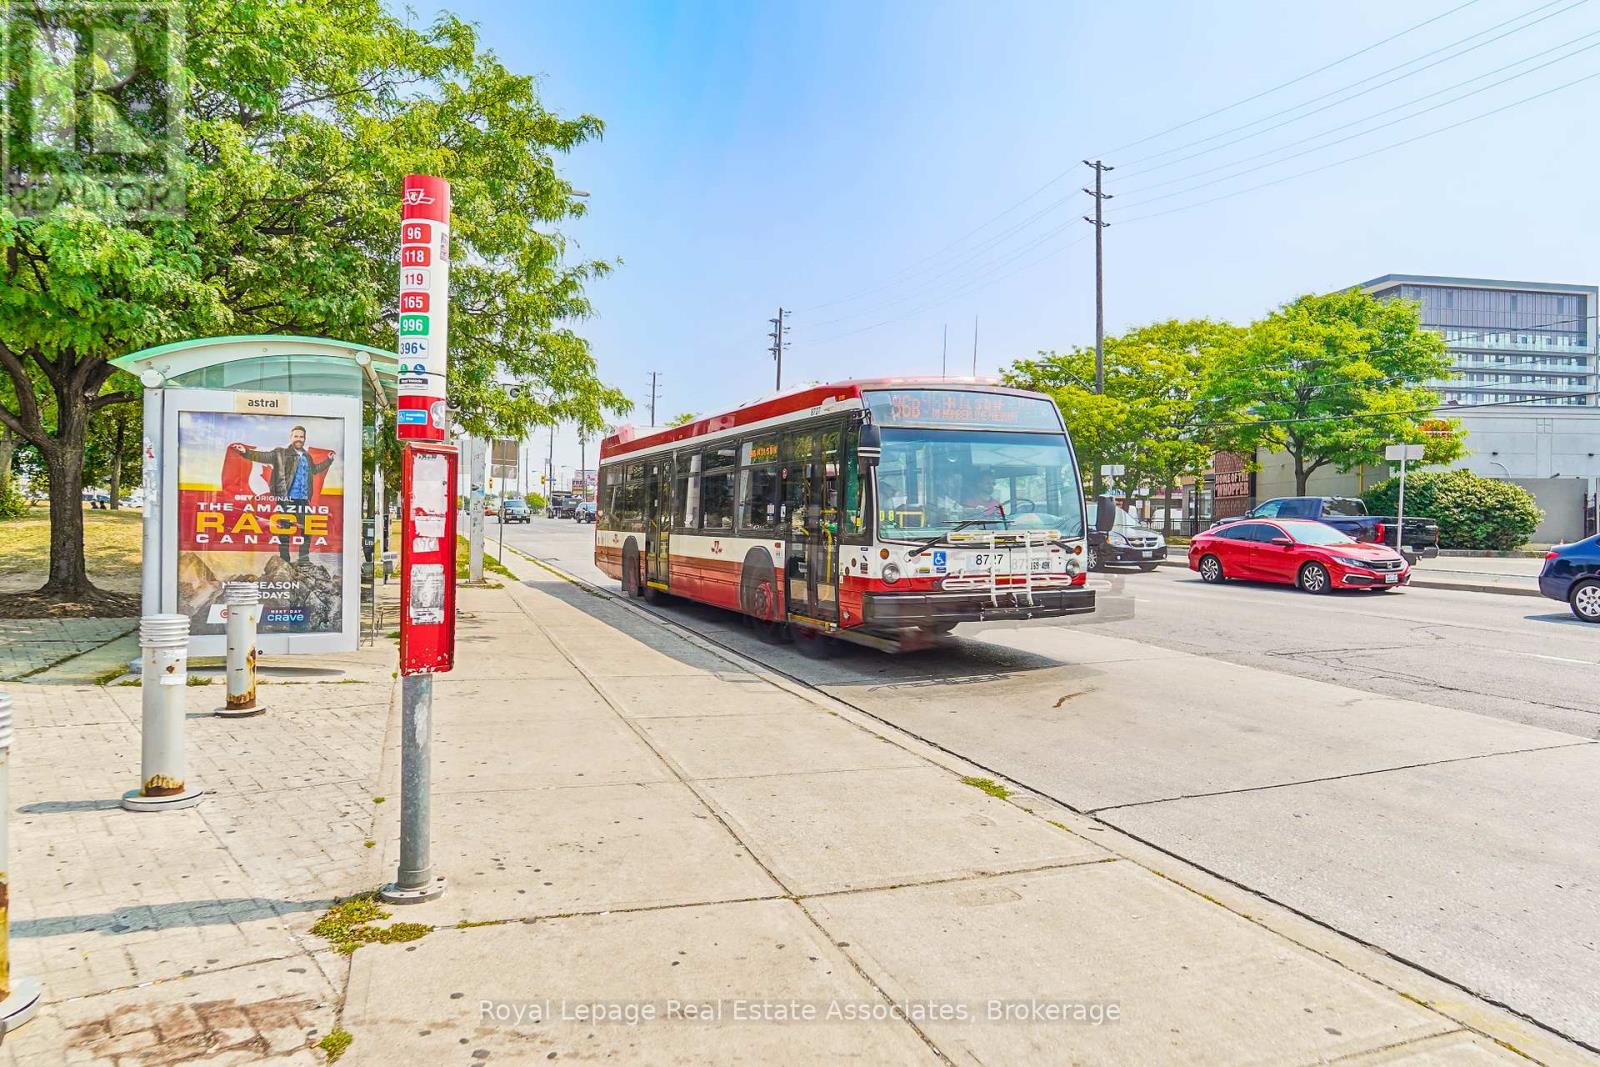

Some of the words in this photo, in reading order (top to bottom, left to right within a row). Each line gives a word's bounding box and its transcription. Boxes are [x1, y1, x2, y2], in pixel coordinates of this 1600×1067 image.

[407, 227, 421, 240] 96
[404, 250, 425, 263] 118
[404, 274, 423, 286] 119
[403, 296, 423, 309] 165
[402, 319, 423, 332] 996
[400, 342, 418, 355] 396
[247, 398, 279, 408] astral
[1215, 482, 1249, 497] WHOPPER
[197, 502, 233, 511] THE
[243, 503, 330, 514] AMAZING
[196, 511, 329, 536] RACE
[195, 534, 328, 546] CANADA
